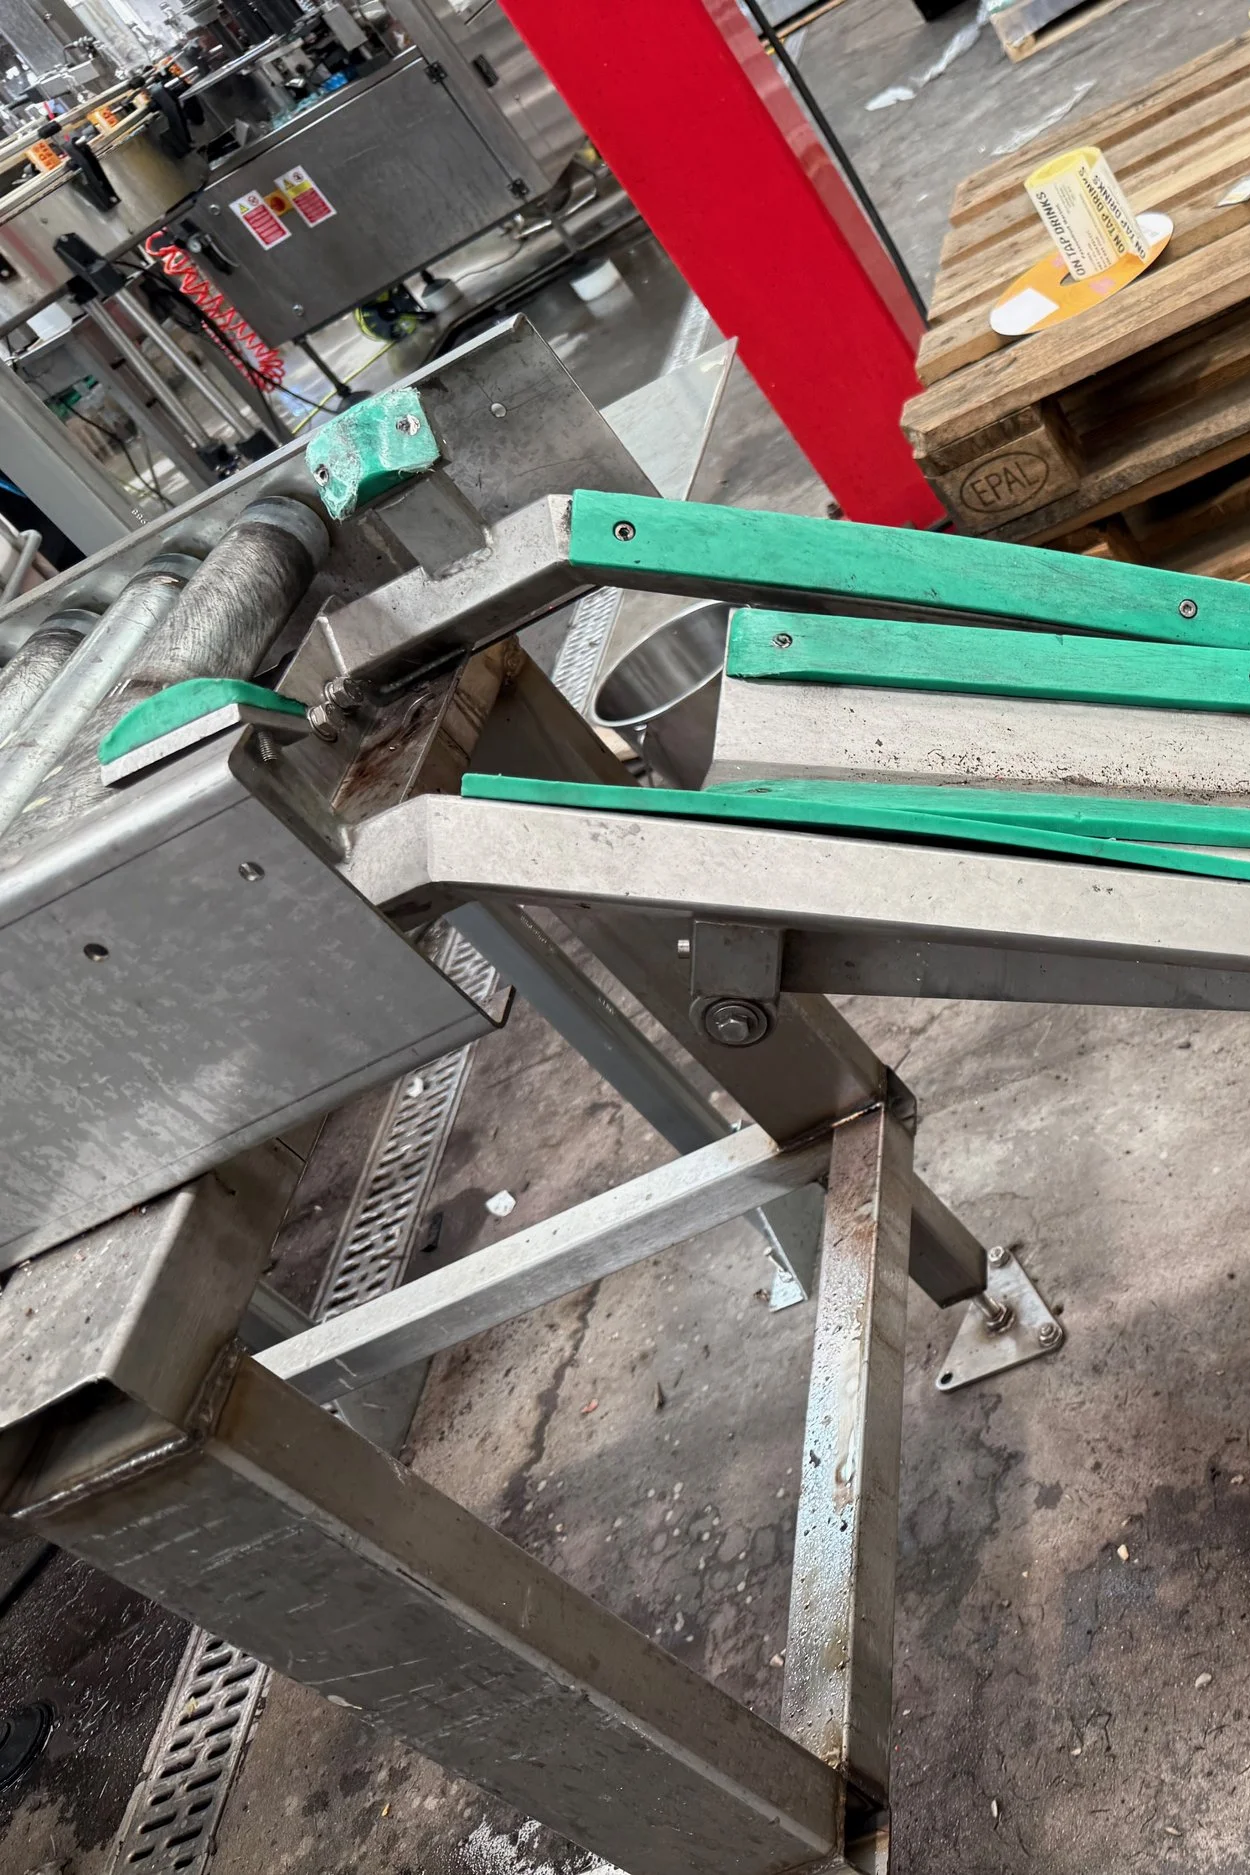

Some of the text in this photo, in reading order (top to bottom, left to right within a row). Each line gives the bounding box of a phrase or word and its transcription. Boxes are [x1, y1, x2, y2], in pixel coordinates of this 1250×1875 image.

[1092, 174, 1122, 222] DRINKS
[1035, 191, 1066, 236] DRINKS
[1101, 212, 1118, 234] TAP
[1120, 220, 1138, 240] TAP
[1058, 236, 1078, 259] TAP
[1113, 235, 1125, 254] ON
[1134, 241, 1146, 260] ON
[1072, 259, 1087, 276] ON
[969, 461, 1040, 507] EPAL
